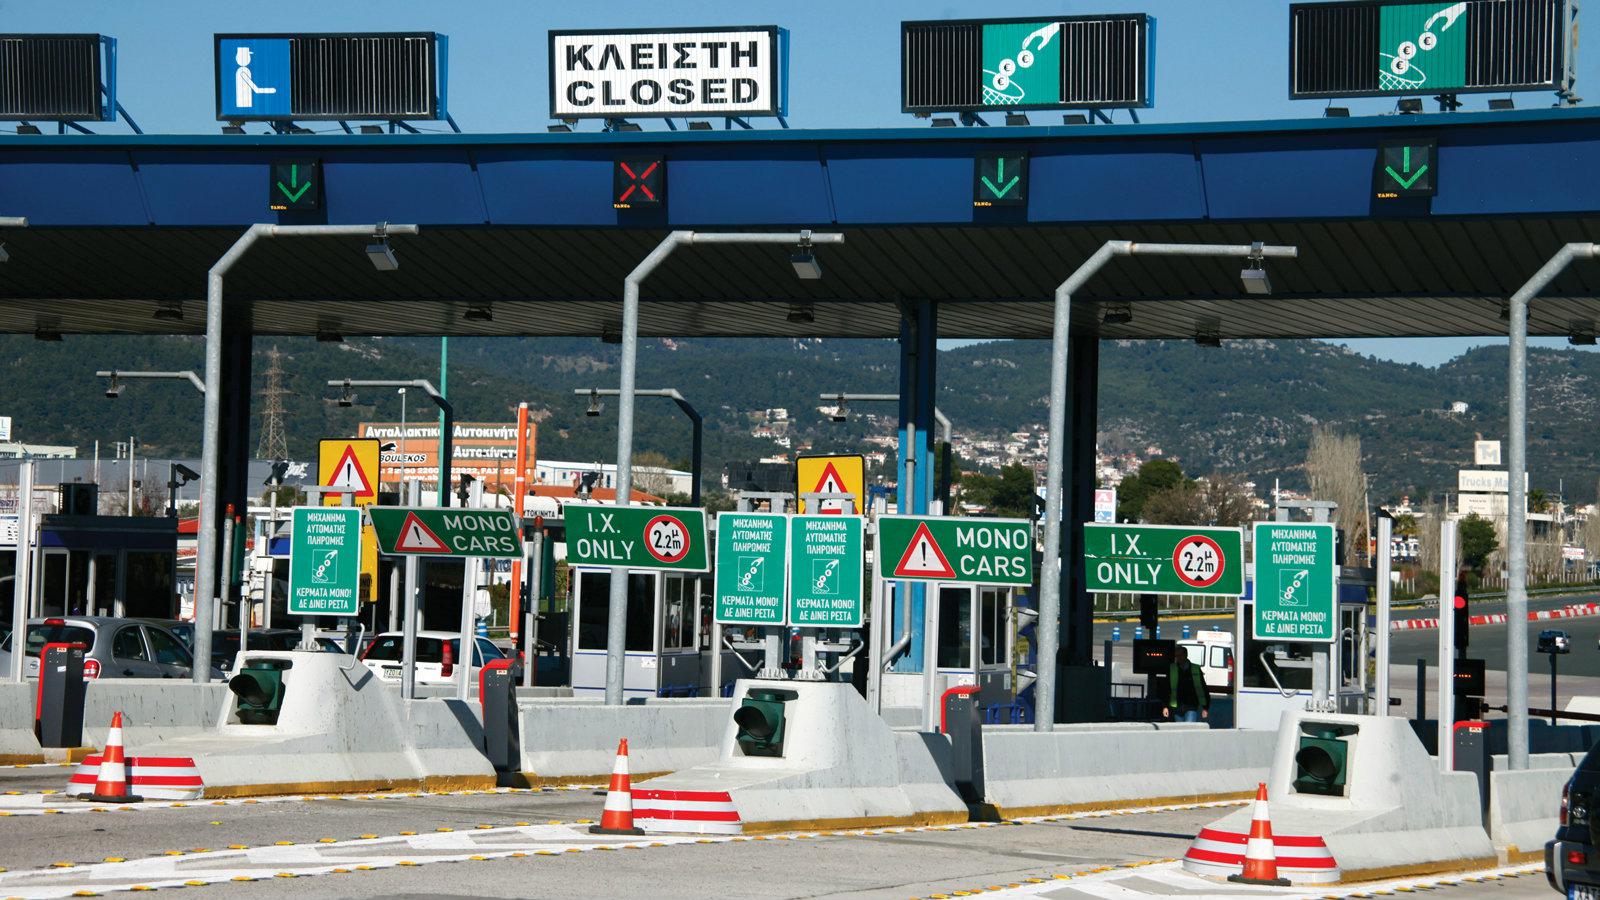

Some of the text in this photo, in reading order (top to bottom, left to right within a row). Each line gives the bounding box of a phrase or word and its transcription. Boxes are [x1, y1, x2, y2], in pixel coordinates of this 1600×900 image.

[565, 41, 758, 71] ΚΛΕΙΣΤΗ
[566, 78, 759, 106] CLOSED
[307, 512, 346, 523] ΜΗΧΑΝΗΜΑ
[306, 524, 346, 534] ΑΥΤΟΜΑΤΗΣ
[732, 519, 773, 529] ΜΗΧΑΝΗΜΑ
[805, 521, 847, 531] ΜΗΧΑΝΗΜΑ
[732, 531, 773, 541] ΑΥΤΟΜΑΤΗΣ
[805, 532, 847, 543] ΑΥΤΟΜΑΤΗΣ
[1271, 529, 1317, 540] ΜΗΧΑΝΗΜΑ
[307, 535, 344, 546] ΠΛΗΡΩΜΗΣ
[453, 535, 514, 552] CARS
[577, 538, 634, 560] ONLY
[733, 542, 771, 553] ΠΛΗΡΩΜΗΣ
[806, 544, 846, 555] ΠΛΗΡΩΜΗΣ
[1271, 541, 1317, 552] ΑΥΤΟΜΑΤΗΣ
[1272, 554, 1316, 565] ΠΛΗΡΩΜΗΣ
[960, 554, 1027, 577] CARS
[1097, 562, 1162, 585] ONLY
[296, 587, 328, 598] ΚΕΡΜΑΤΑ
[329, 588, 352, 598] ΜΟΝΟ!
[298, 599, 349, 609] ΔΕ ΔΙΝΕΙ ΡΕΣΤΑ
[722, 596, 779, 606] ΚΕΡΜΑΤΑ ΜΟΝΟ!
[796, 598, 855, 609] ΚΕΡΜΑΤΑ ΜΟΝΟ!
[724, 607, 775, 618] ΔΕ ΔΙΝΕΙ ΡΕΣΤΑ
[799, 610, 852, 621] ΔΕ ΔΙΝΕΙ ΡΕΣΤΑ
[1261, 610, 1327, 622] ΚΕΡΜΑΤΑ ΜΟΝΟ!
[1265, 622, 1324, 634] ΔΕ ΔΙΝΕΙ ΡΕΣΤΑ
